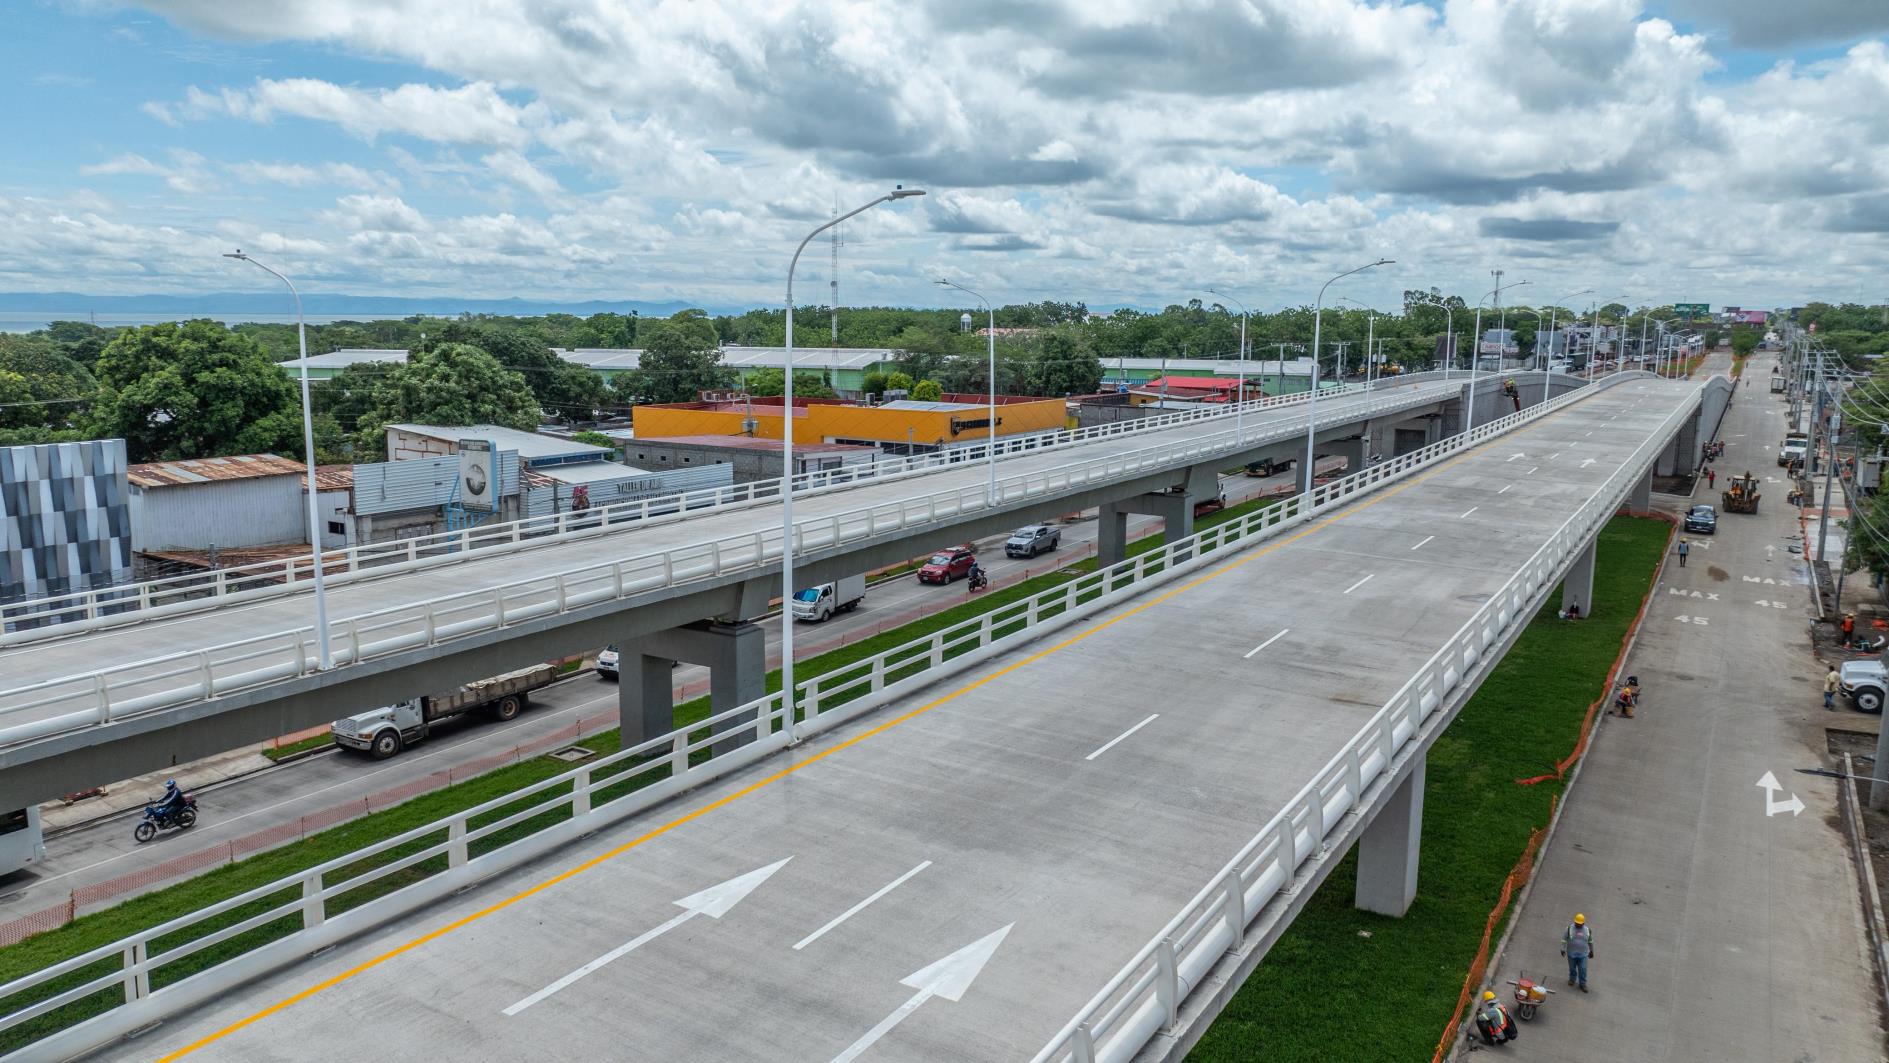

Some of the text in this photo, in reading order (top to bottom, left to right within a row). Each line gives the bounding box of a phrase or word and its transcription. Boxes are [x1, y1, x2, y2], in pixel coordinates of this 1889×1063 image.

[1742, 575, 1792, 587] MAX
[1669, 587, 1720, 601] MAX
[1754, 600, 1788, 609] 45
[1673, 614, 1709, 626] 45
